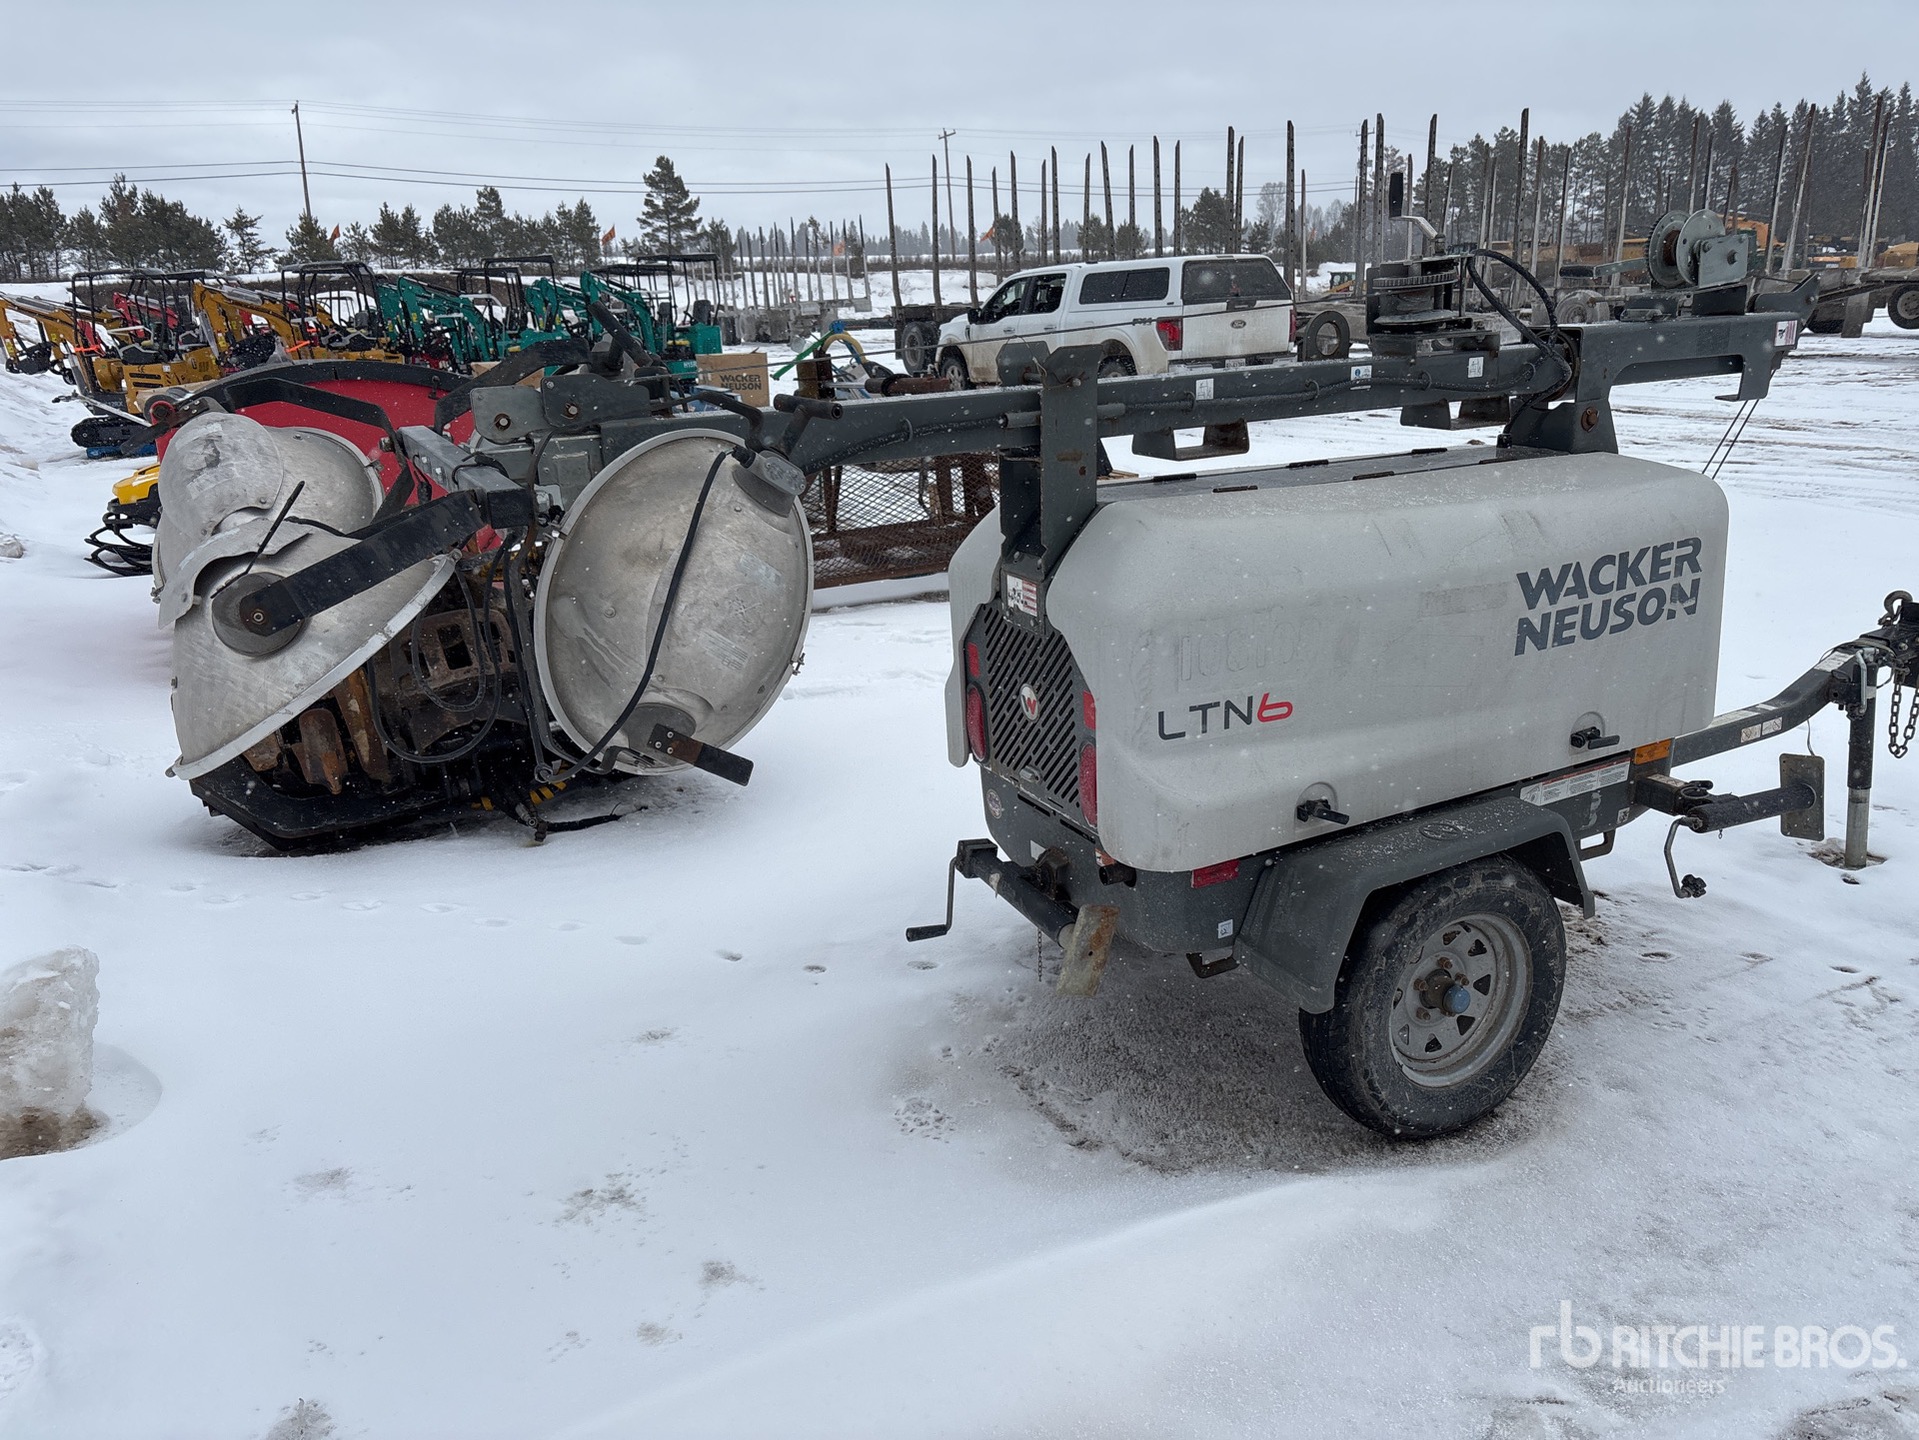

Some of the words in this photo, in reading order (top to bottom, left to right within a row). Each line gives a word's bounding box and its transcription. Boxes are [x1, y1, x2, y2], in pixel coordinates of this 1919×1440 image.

[720, 374, 760, 383] WACKER
[721, 382, 762, 391] NEUSON
[1516, 537, 1702, 610] WACKER
[1514, 578, 1701, 656] NEUSON
[1157, 692, 1294, 741] LTN6
